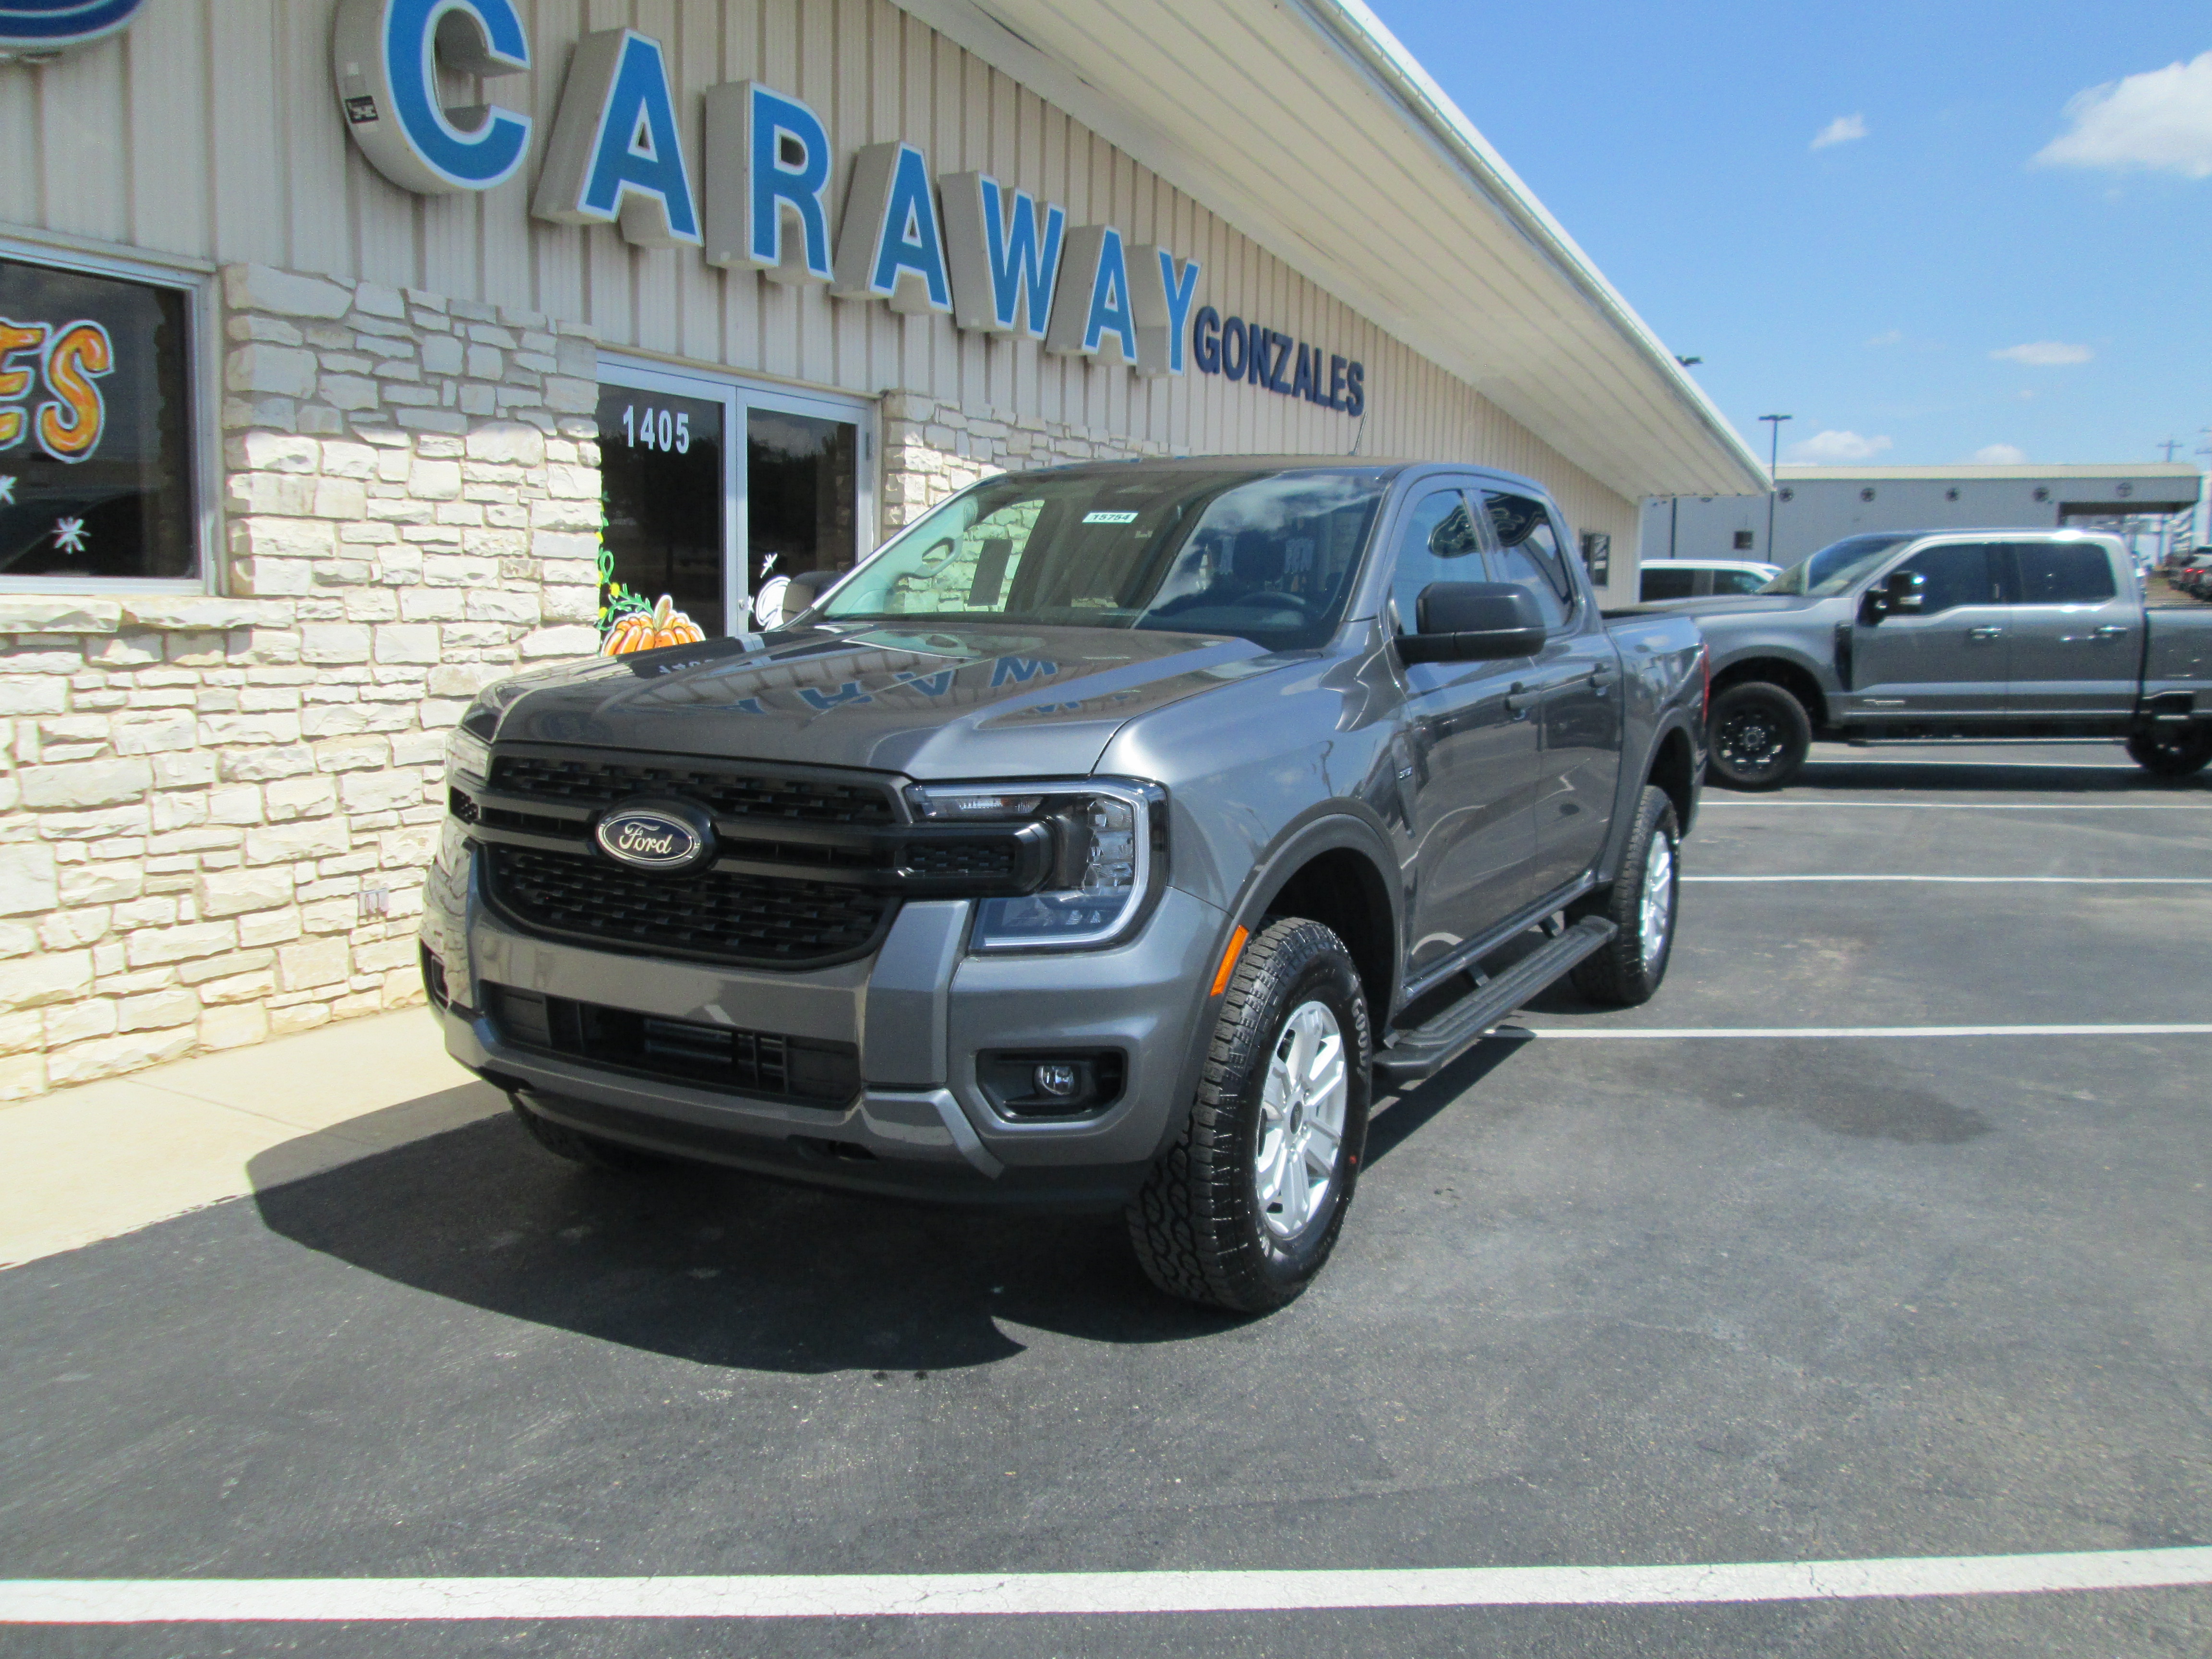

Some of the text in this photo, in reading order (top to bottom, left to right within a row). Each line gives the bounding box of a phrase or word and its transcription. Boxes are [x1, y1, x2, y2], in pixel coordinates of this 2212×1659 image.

[383, 0, 1202, 377] CARAWAY
[1193, 305, 1365, 417] GONZALES
[624, 405, 690, 454] 1405
[619, 821, 673, 854] Ford
